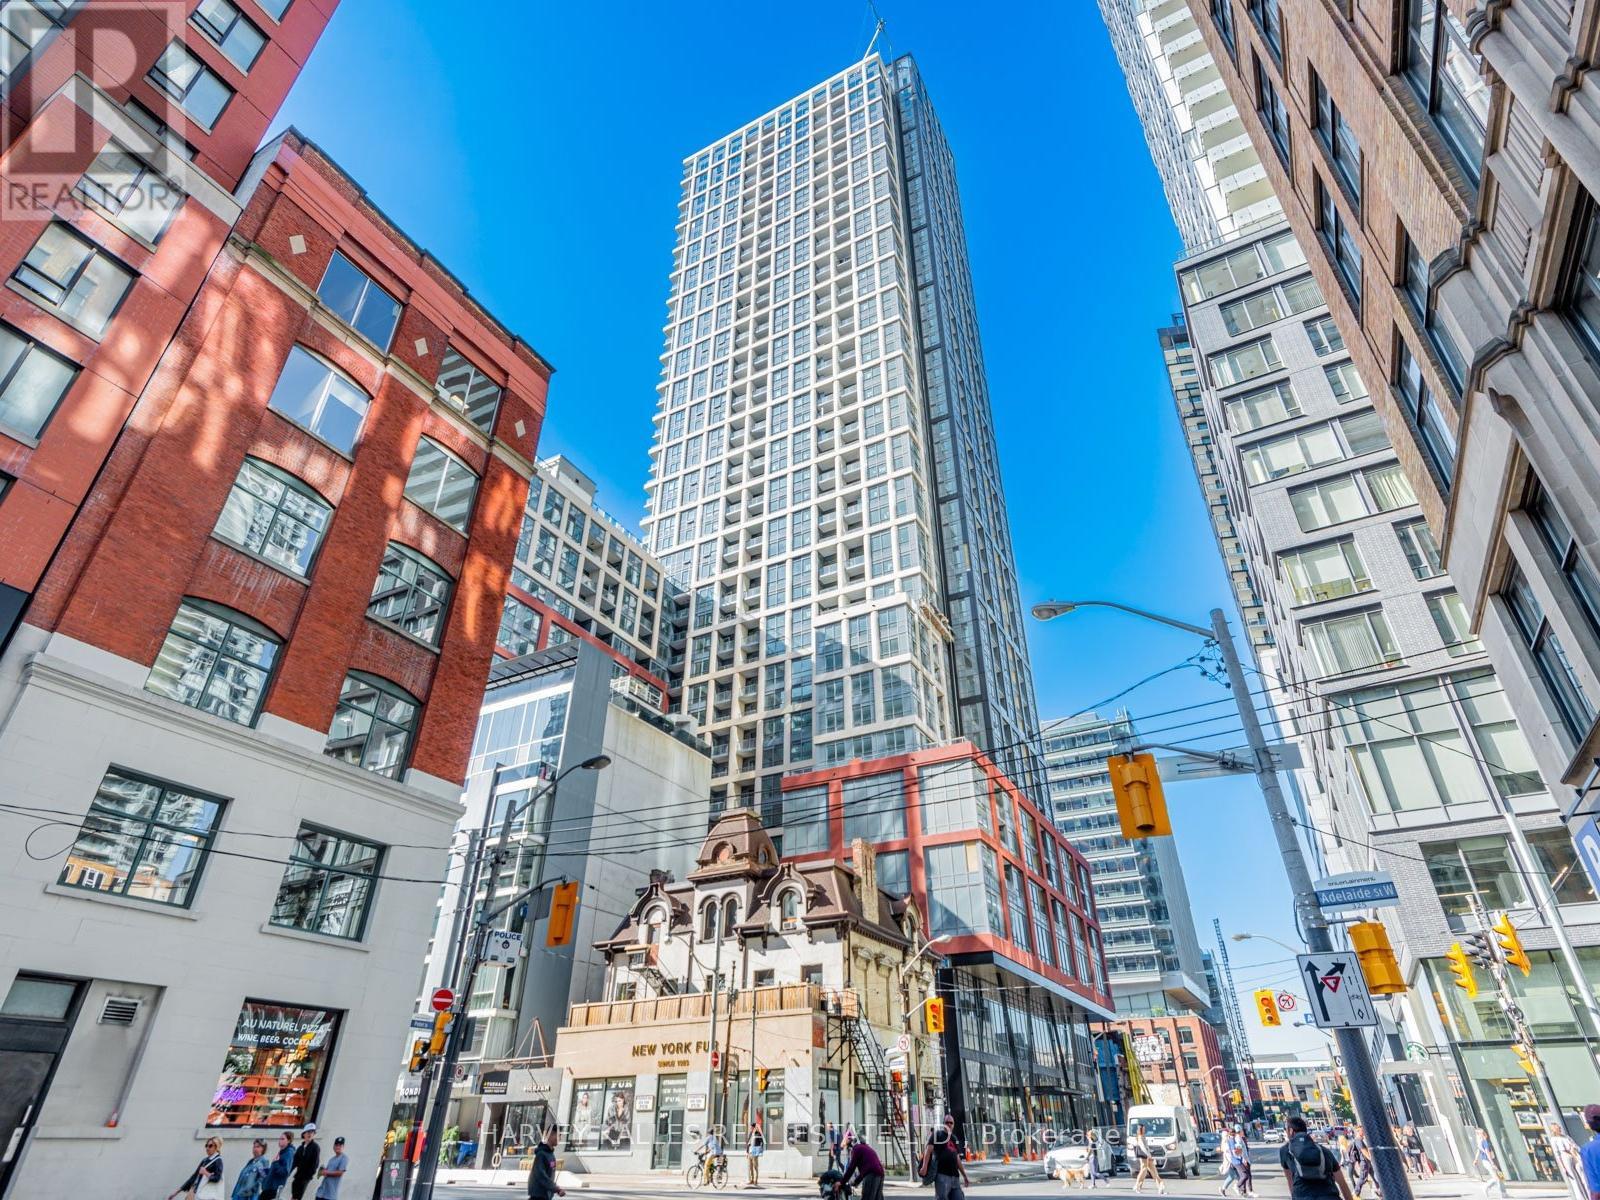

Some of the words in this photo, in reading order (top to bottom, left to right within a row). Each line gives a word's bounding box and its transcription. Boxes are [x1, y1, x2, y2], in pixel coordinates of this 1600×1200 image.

[1320, 888, 1371, 904] Adelaide
[1383, 883, 1395, 896] W
[494, 931, 522, 941] POLICE
[241, 1019, 257, 1029] AU
[258, 1019, 299, 1032] NATUREL
[631, 1044, 657, 1057] NEW
[661, 1041, 692, 1055] YORK
